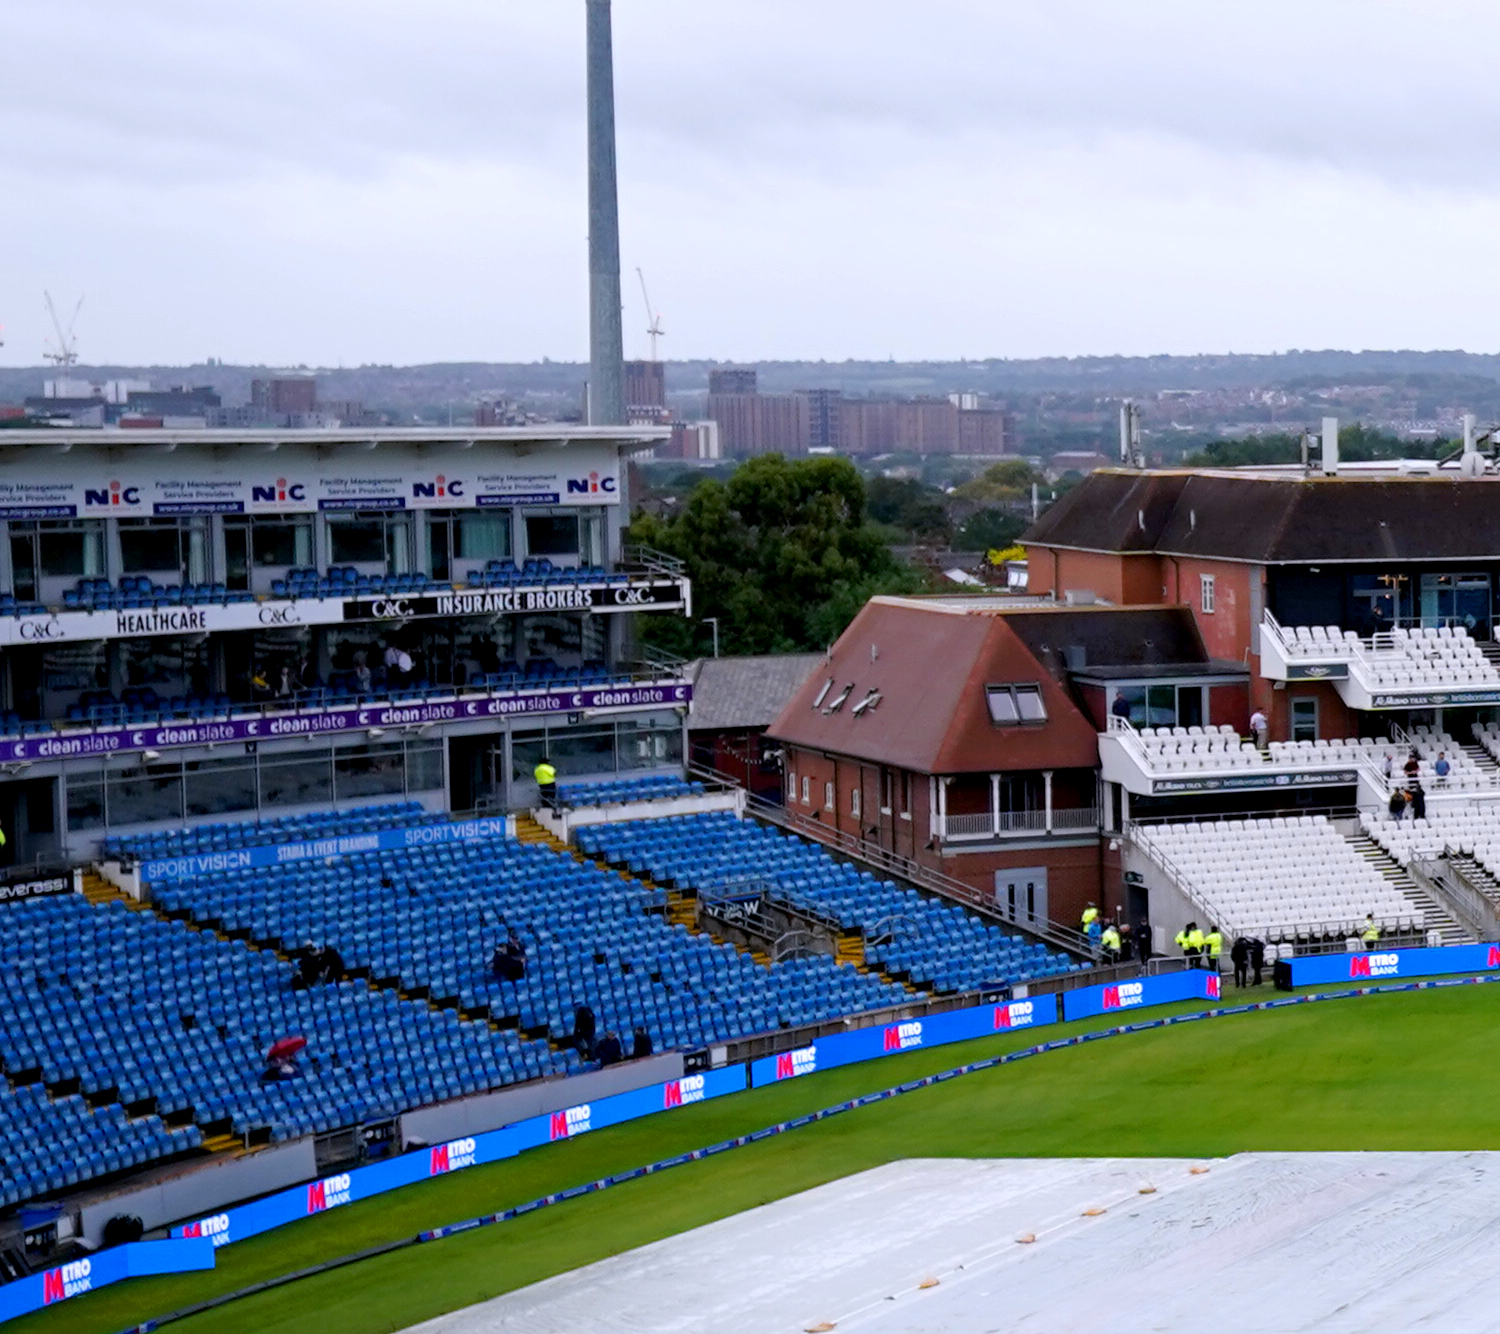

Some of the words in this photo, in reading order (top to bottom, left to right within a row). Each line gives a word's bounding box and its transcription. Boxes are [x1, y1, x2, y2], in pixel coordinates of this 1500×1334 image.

[437, 593, 521, 614] INSURANCE
[526, 589, 593, 610] BROKERS
[117, 611, 206, 634] HEALTHCARE
[1104, 983, 1142, 1008] METRO
[1120, 996, 1142, 1006] BANK
[666, 1075, 704, 1107] METRO
[681, 1090, 703, 1104] BANK
[309, 1174, 350, 1212] METRO
[326, 1192, 350, 1208] BANK
[45, 1259, 90, 1303] METRO
[65, 1280, 90, 1297] BANK
